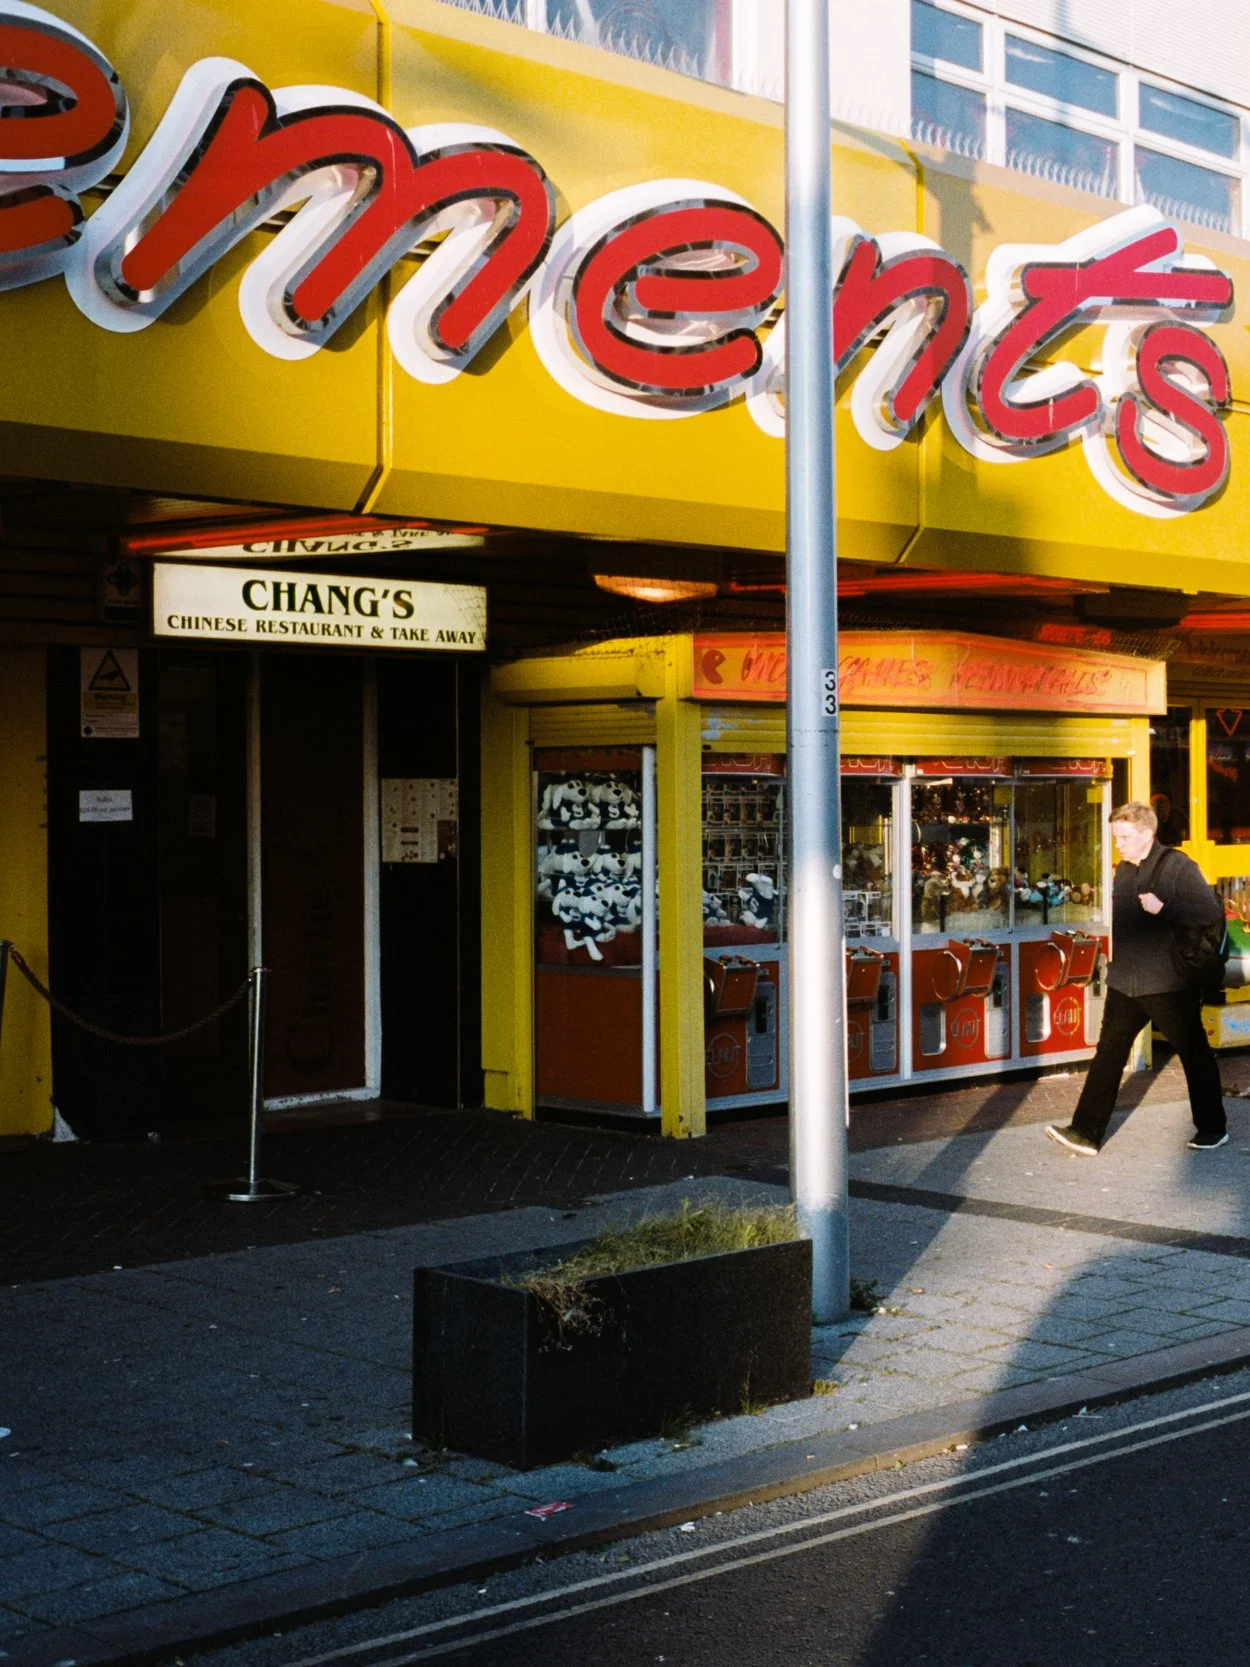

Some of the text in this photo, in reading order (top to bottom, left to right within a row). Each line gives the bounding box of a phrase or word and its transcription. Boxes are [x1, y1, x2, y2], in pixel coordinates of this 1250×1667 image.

[242, 579, 415, 620] CHANG'S
[167, 614, 477, 645] CHINESE RESTAURANT & TAKE AWAY
